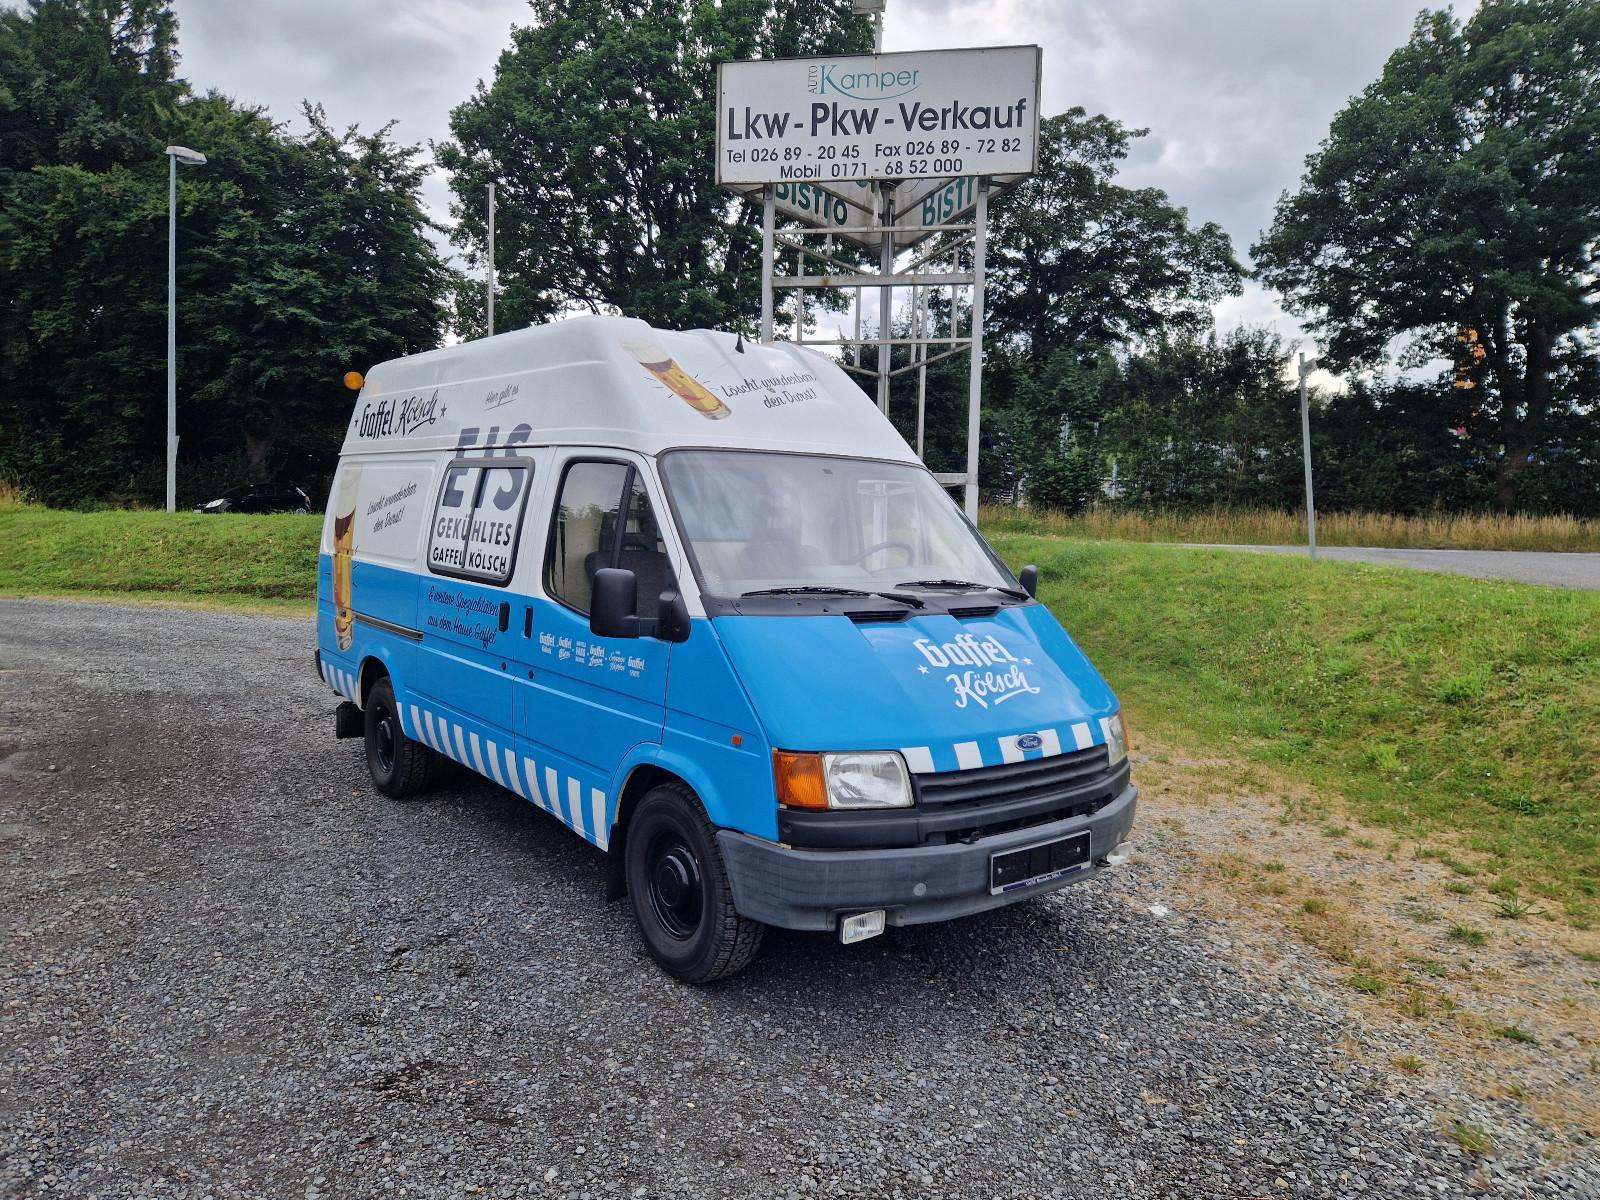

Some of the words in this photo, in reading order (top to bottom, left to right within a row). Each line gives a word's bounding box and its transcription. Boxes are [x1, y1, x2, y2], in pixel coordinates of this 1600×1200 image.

[808, 65, 818, 94] AUTO
[817, 64, 920, 98] Kamper
[728, 107, 791, 140] Lkw
[811, 101, 880, 137] Pkw
[899, 97, 1027, 132] Verkauf
[727, 150, 746, 163] Tel
[751, 148, 779, 162] 026
[784, 147, 801, 161] 89
[817, 145, 836, 160] 20
[841, 144, 860, 159] 45
[875, 143, 901, 157] Fax
[906, 141, 935, 156] 026
[940, 139, 960, 154] 89
[977, 138, 996, 153] 72
[1001, 137, 1021, 152] 82
[780, 163, 821, 179] Mobil
[831, 162, 868, 178] 0171
[884, 160, 904, 175] 68
[909, 159, 928, 174] 52
[933, 158, 963, 173] 000
[360, 400, 396, 440] Gaffel
[394, 389, 439, 437] Kölsch
[763, 394, 787, 409] den
[442, 423, 533, 511] EIS
[437, 513, 513, 546] GEKÜHLTES
[432, 547, 463, 567] GAFFEL
[468, 548, 507, 573] KÖLSCH
[453, 616, 474, 638] Hause
[912, 634, 1019, 668] Gaffel
[946, 665, 1041, 709] Kölsch
